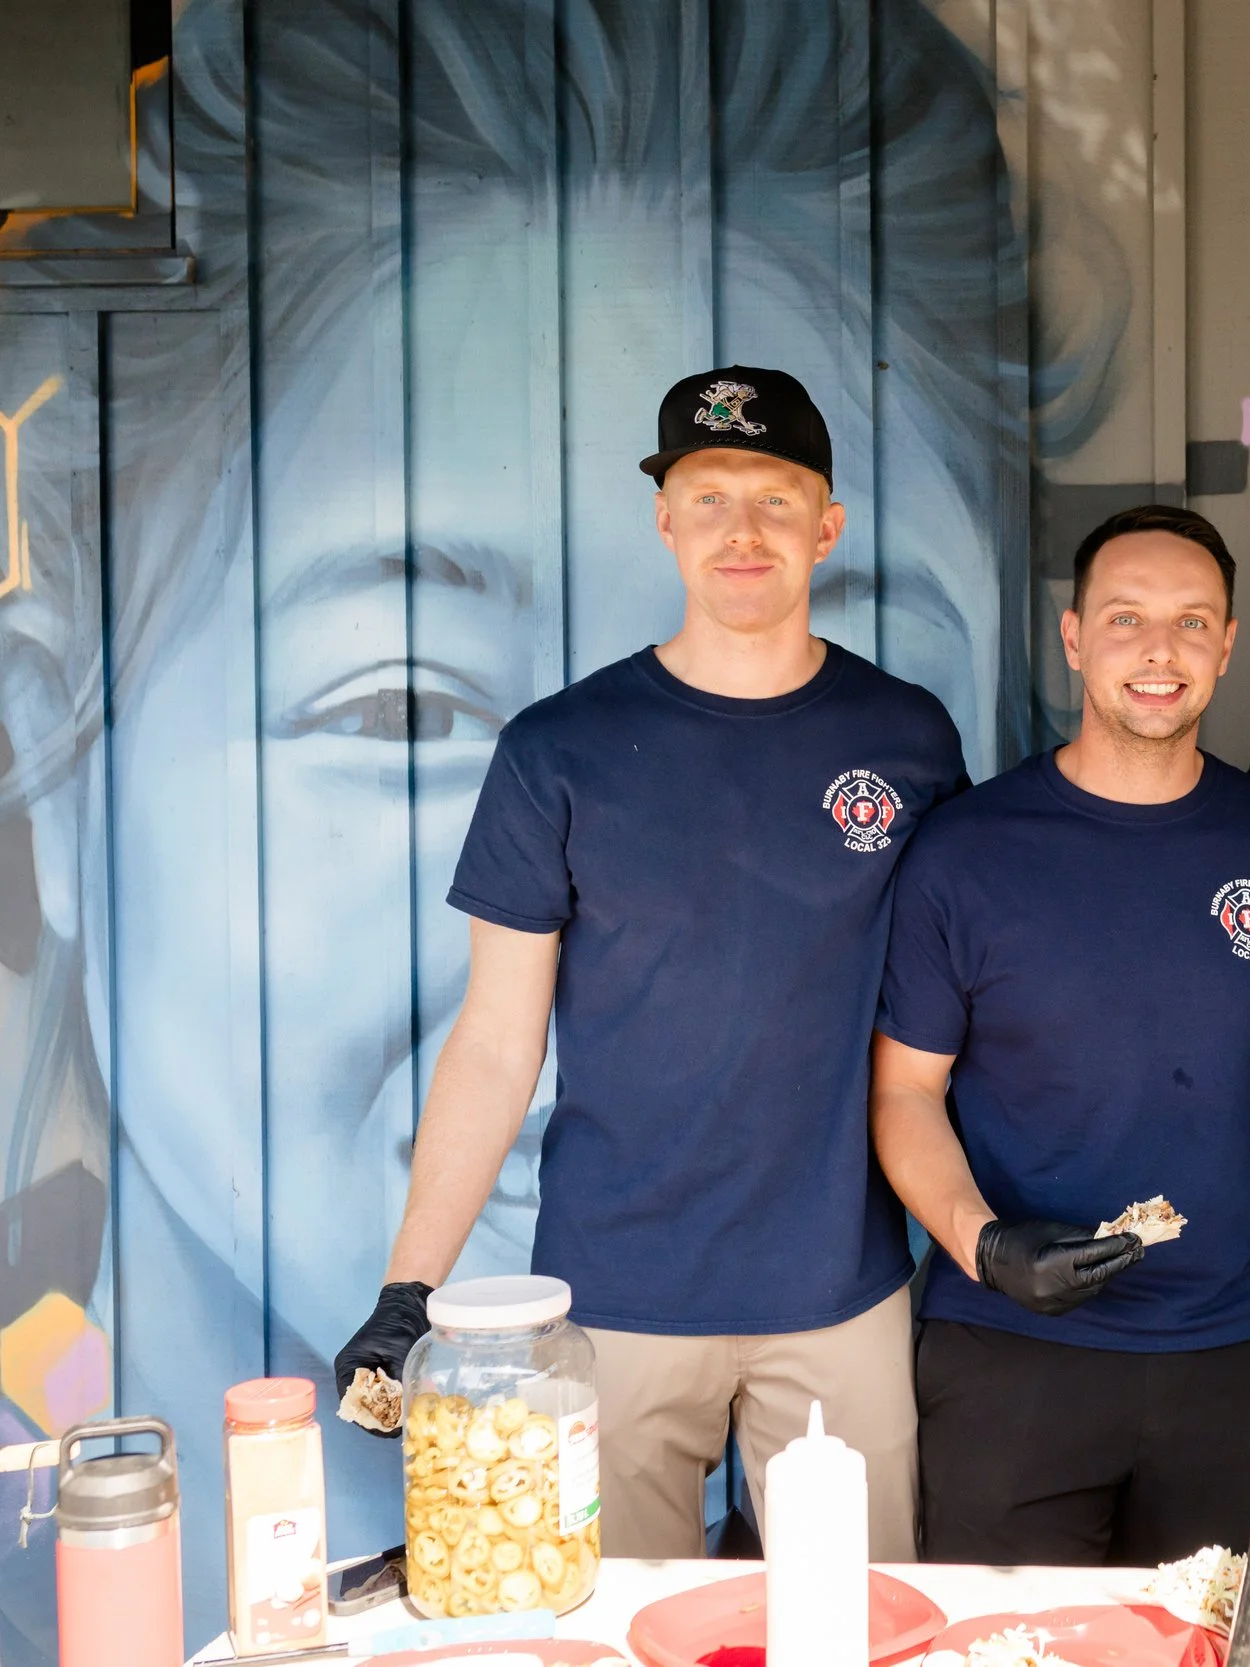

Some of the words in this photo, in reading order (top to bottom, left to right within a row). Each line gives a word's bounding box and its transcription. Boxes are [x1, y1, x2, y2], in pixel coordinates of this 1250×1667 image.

[822, 771, 850, 809] BURNABY
[852, 769, 870, 779] FIRE
[871, 773, 903, 810] FIGHTERS
[844, 838, 877, 852] LOCAL
[877, 836, 892, 850] 323
[1210, 881, 1234, 916] BURNABY
